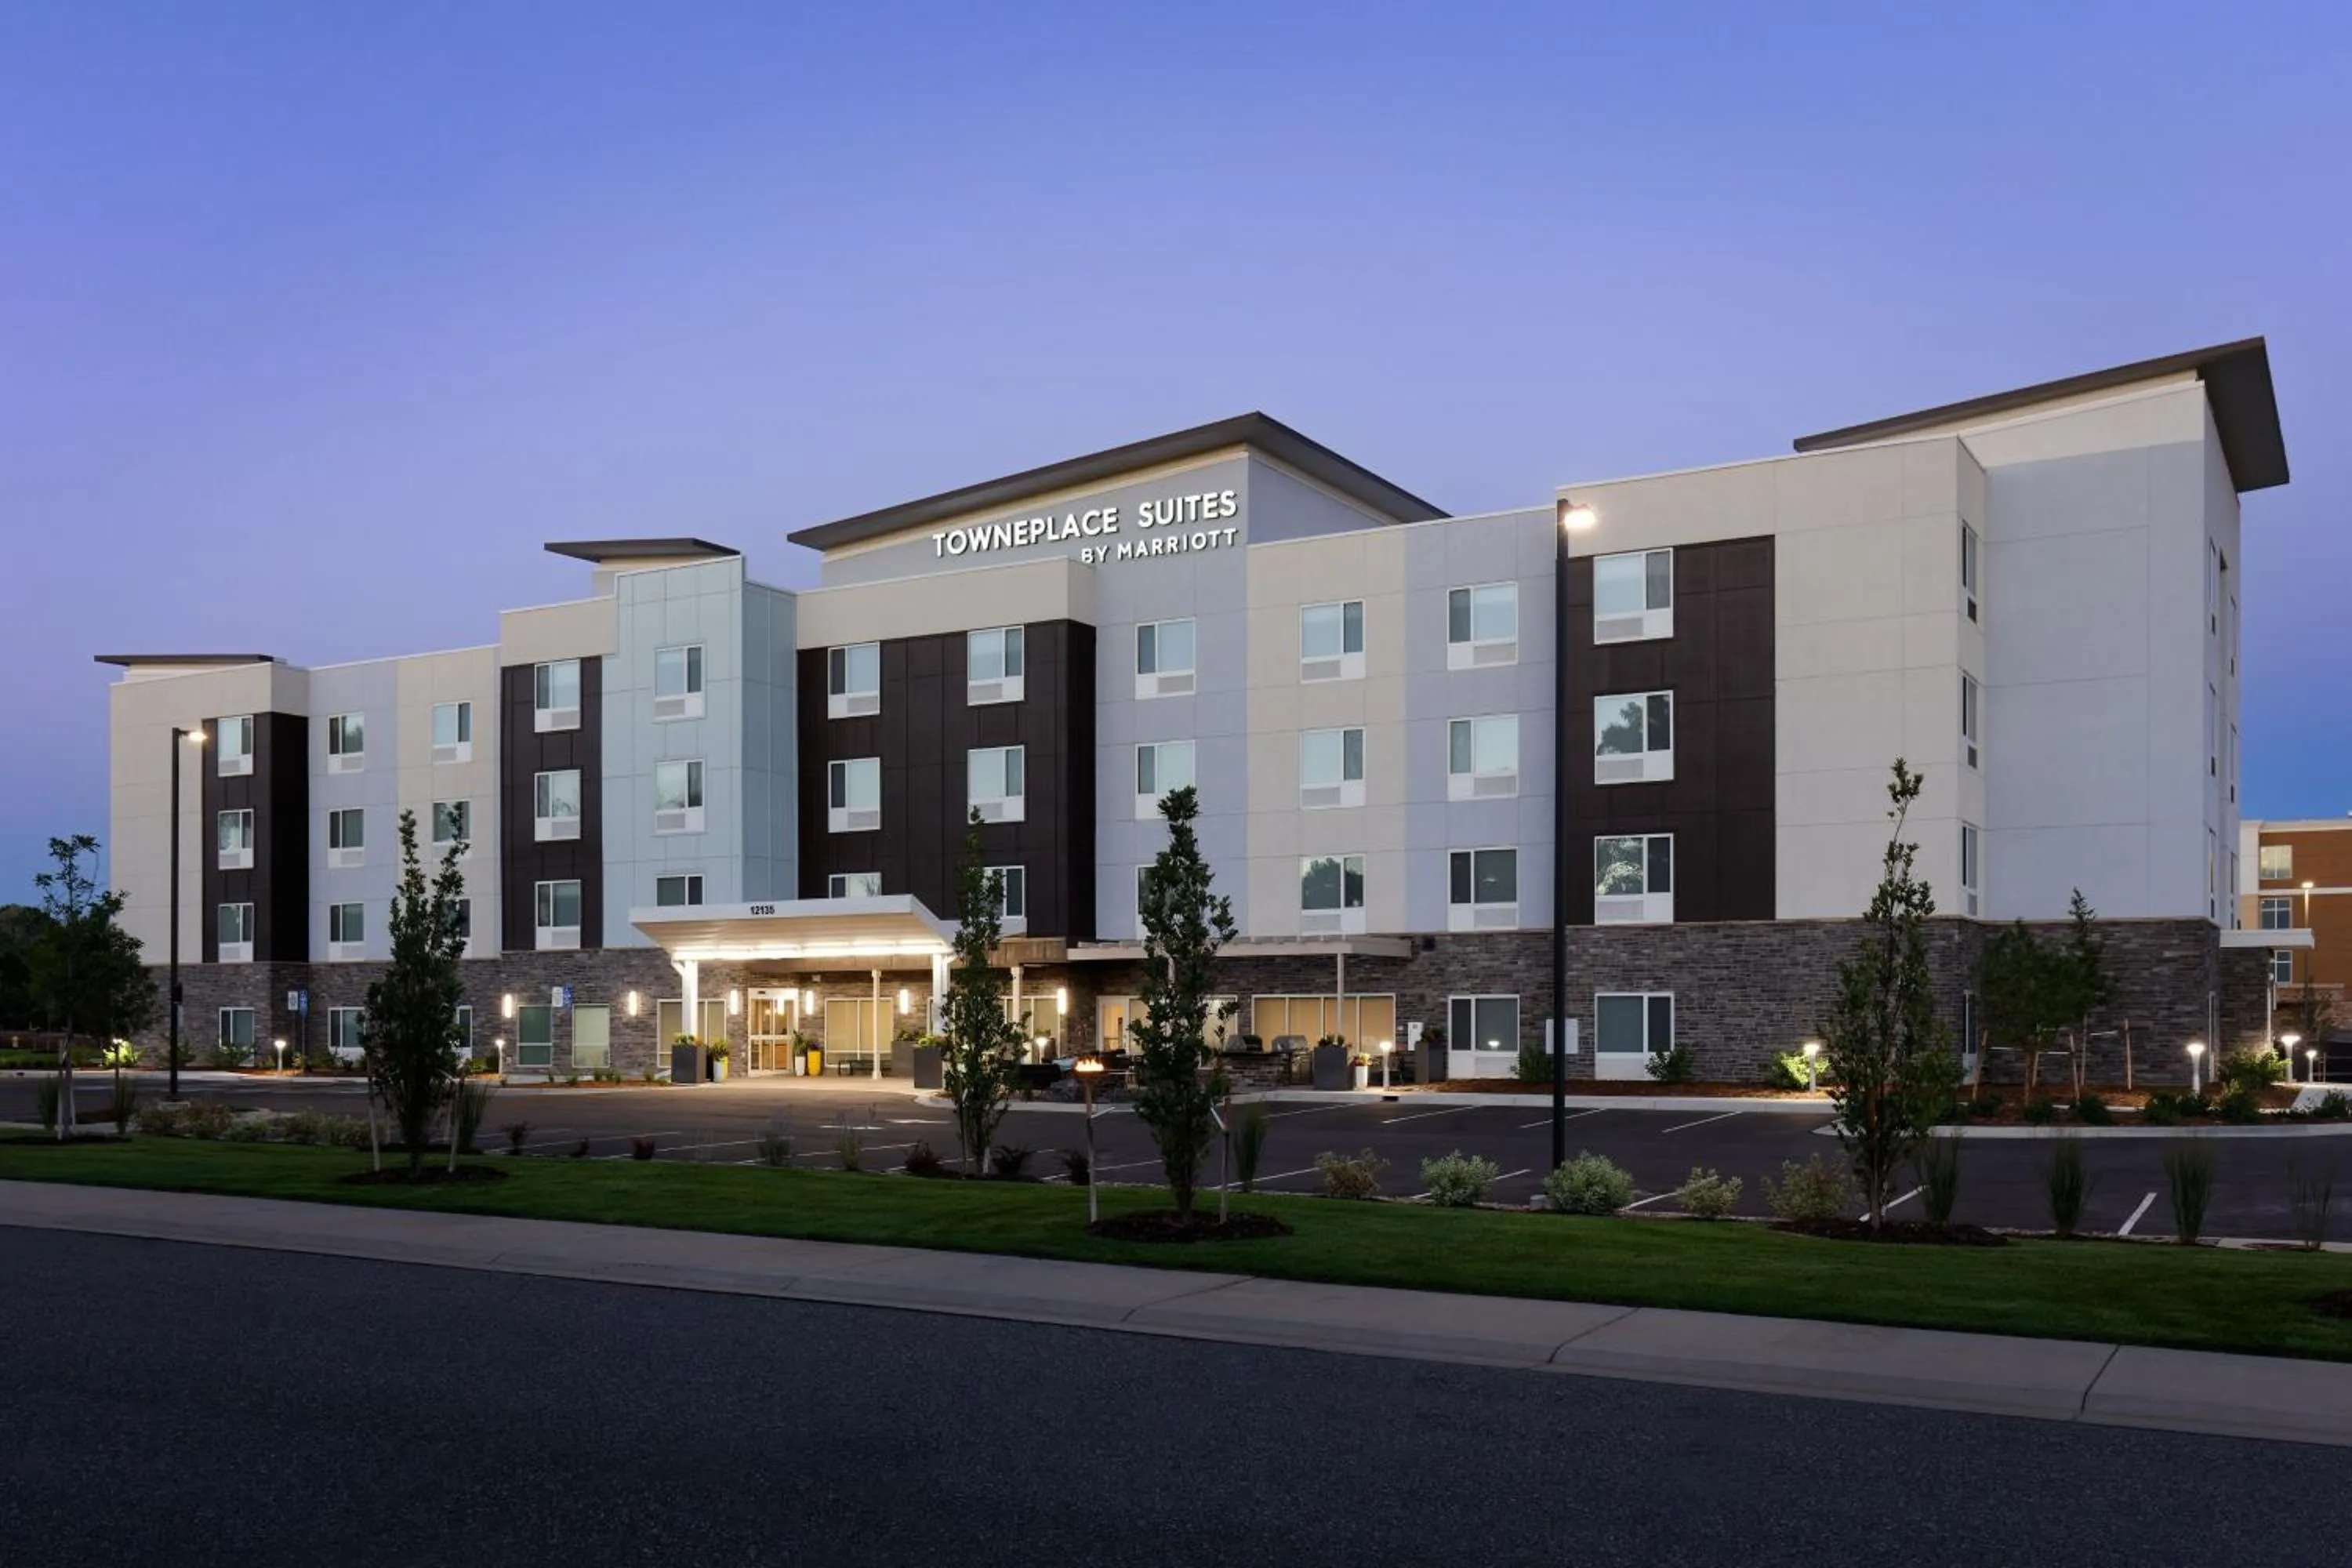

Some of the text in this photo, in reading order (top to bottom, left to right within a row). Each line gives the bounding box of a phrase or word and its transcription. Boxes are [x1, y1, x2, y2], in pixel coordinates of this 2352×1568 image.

[932, 490, 1238, 557] TOWNEPLACE SUITES
[1082, 528, 1238, 564] BY MARRIOTT
[750, 905, 775, 915] 12135
